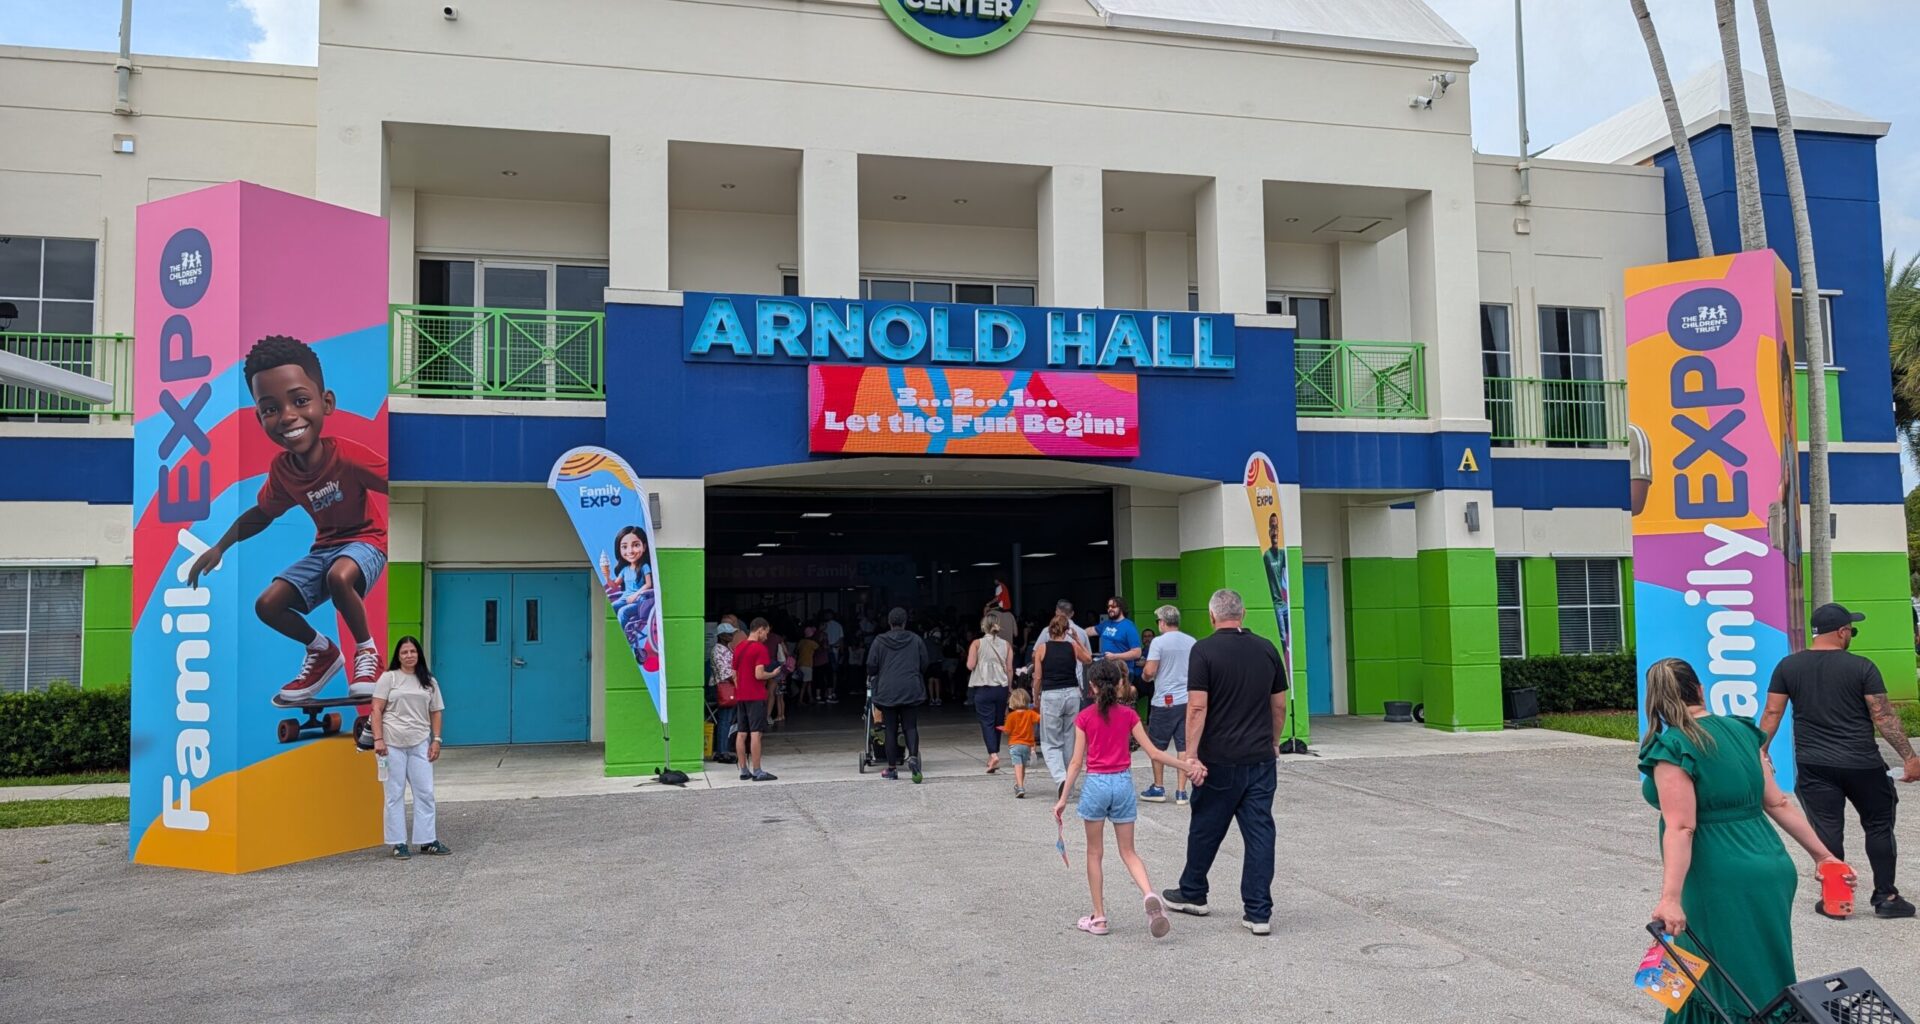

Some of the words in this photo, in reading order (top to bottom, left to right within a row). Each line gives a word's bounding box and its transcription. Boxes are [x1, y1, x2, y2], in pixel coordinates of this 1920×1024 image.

[169, 264, 181, 273] THE
[169, 267, 202, 280] CHILDREN'S
[178, 276, 198, 286] TRUST
[1681, 315, 1698, 323] THE
[1681, 318, 1728, 329] CHILDREN'S
[690, 297, 1027, 364] ARNOLD
[1047, 311, 1236, 370] HALL
[1695, 325, 1721, 334] TRUST
[158, 227, 213, 524] EXPO
[1667, 287, 1750, 520] EXPO
[824, 411, 881, 432] Let
[888, 412, 945, 433] the
[952, 414, 1017, 433] Fun
[1023, 410, 1126, 438] Begin!
[1457, 447, 1480, 472] A
[306, 480, 339, 502] Family
[579, 484, 621, 497] Family
[580, 495, 622, 508] EXPO
[1256, 496, 1274, 507] EXPO
[1684, 523, 1769, 717] amily
[161, 528, 223, 831] Family
